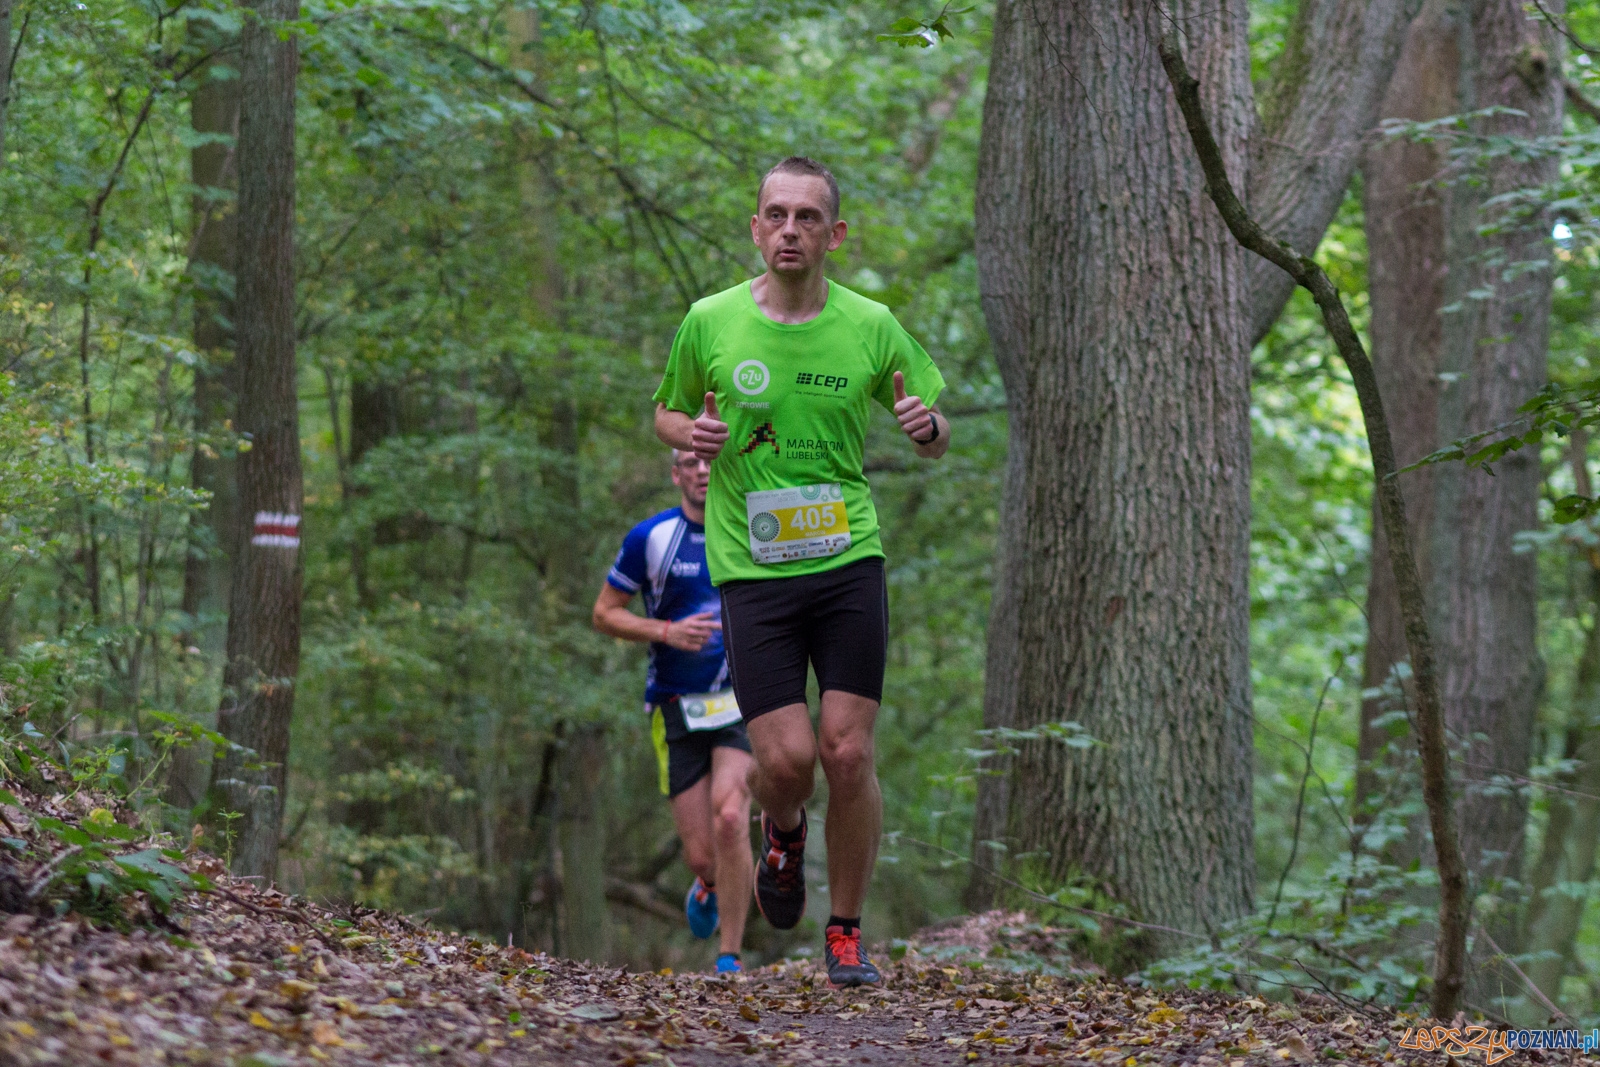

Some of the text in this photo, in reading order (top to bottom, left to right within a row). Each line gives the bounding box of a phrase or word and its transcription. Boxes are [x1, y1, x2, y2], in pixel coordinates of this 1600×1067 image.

[741, 370, 762, 385] PZU
[814, 374, 849, 392] cep
[735, 401, 770, 409] ZDROWIE
[787, 439, 844, 452] MARATON
[787, 451, 829, 460] LUBELSKI
[790, 505, 836, 530] 405
